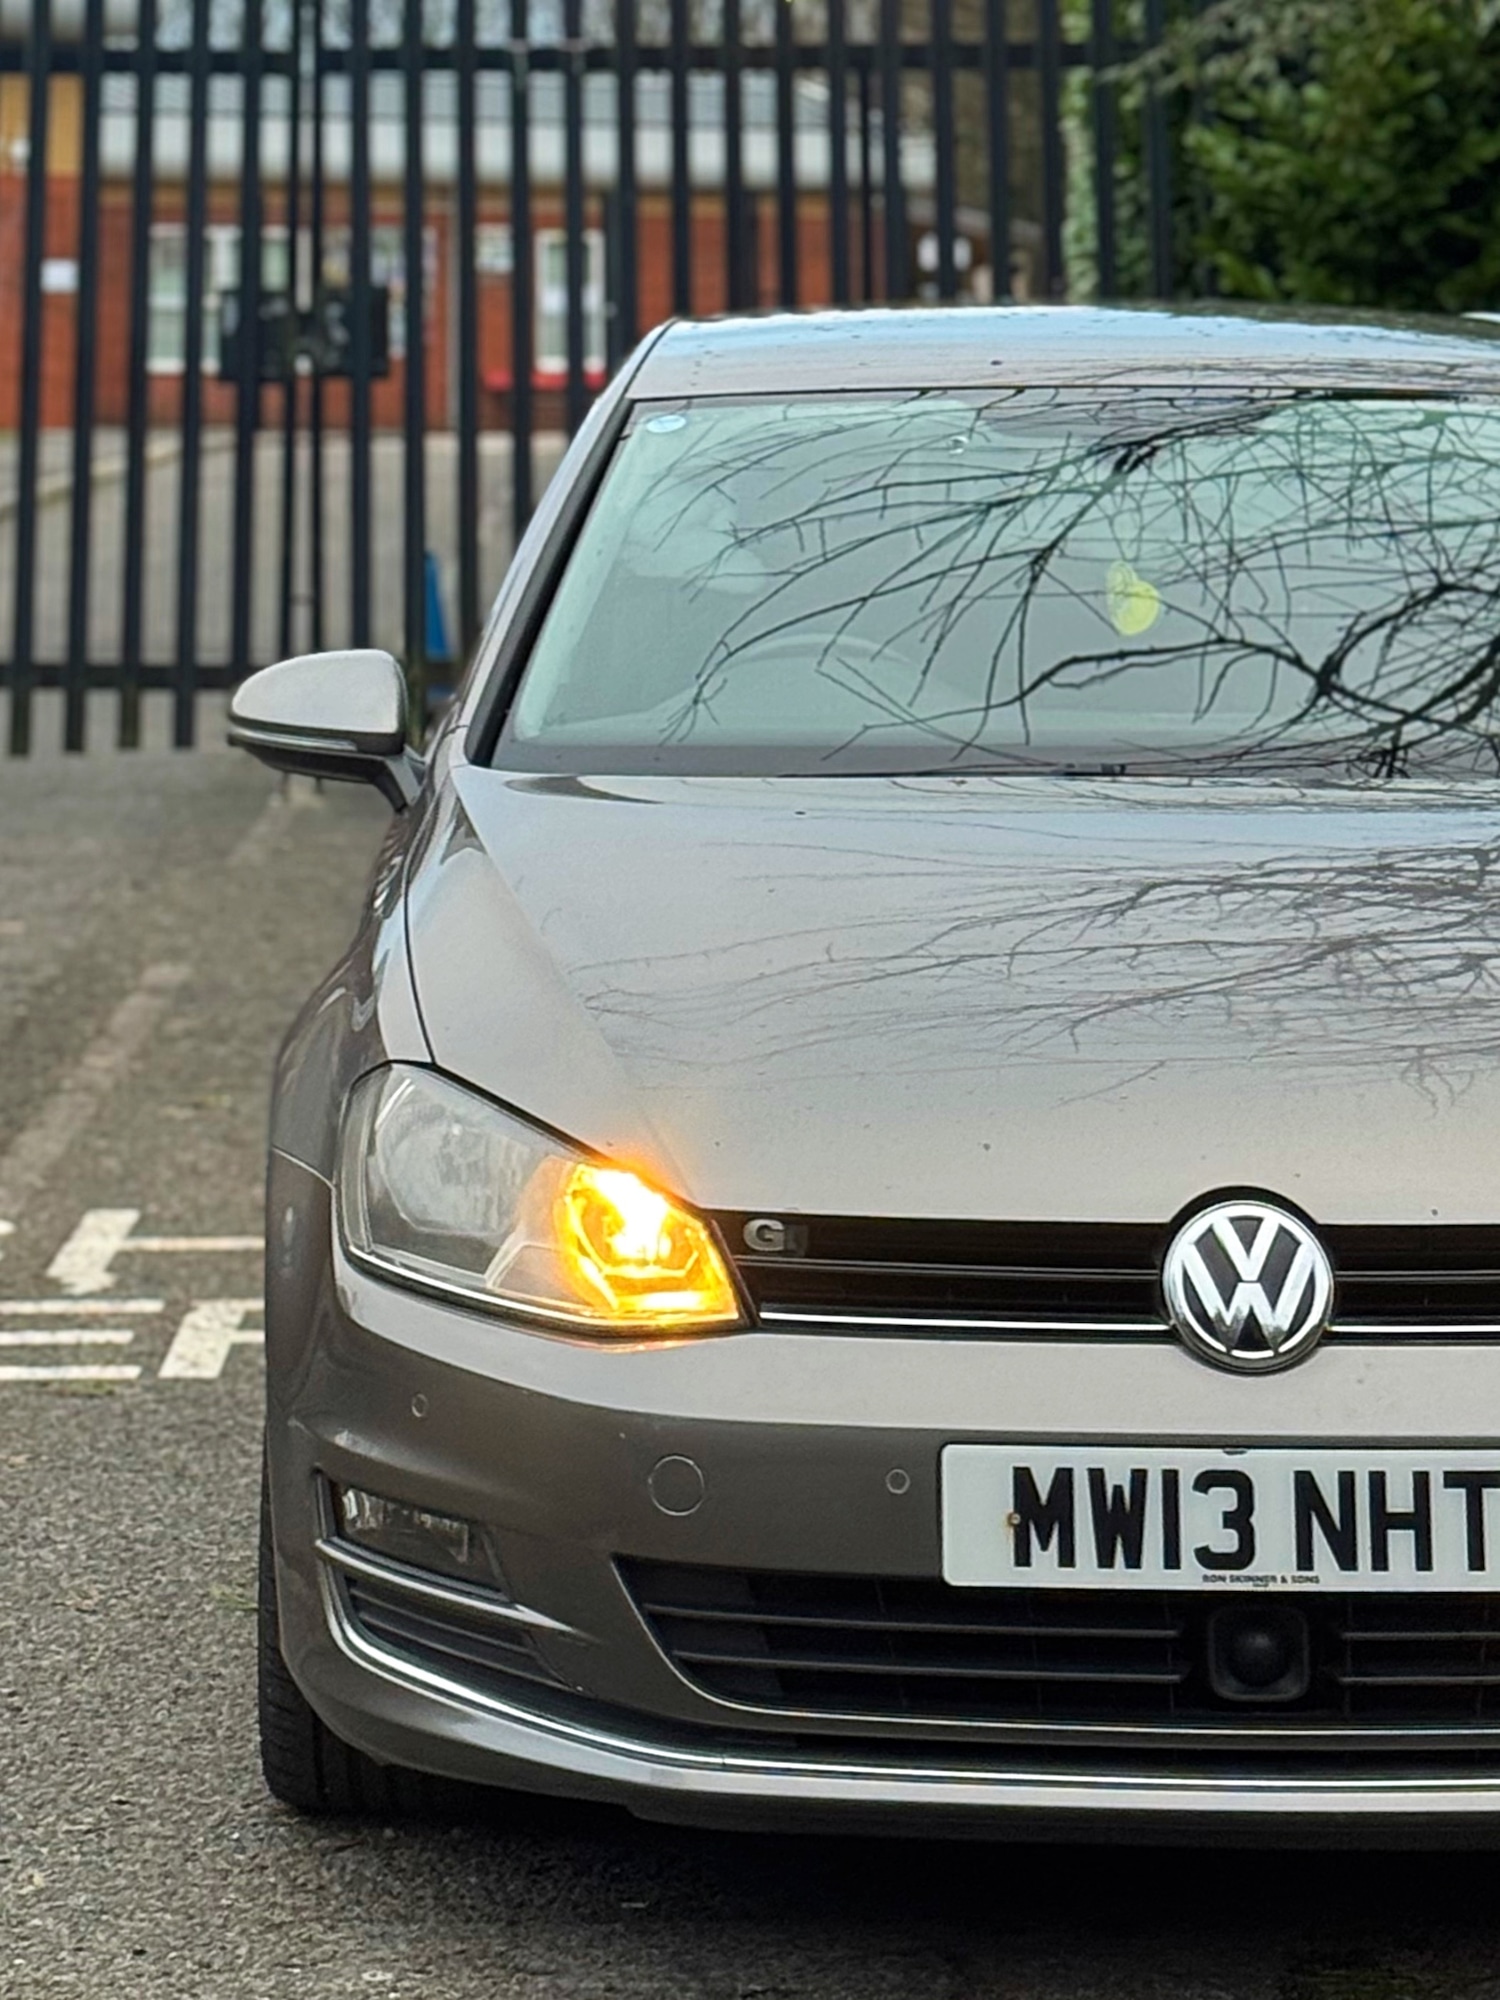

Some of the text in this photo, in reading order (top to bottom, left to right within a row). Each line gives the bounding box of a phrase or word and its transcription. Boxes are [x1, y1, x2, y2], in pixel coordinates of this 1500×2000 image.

[1012, 1466, 1500, 1573] MW13 NHT
[1202, 1574, 1227, 1583] RON
[1291, 1575, 1320, 1585] SONS
